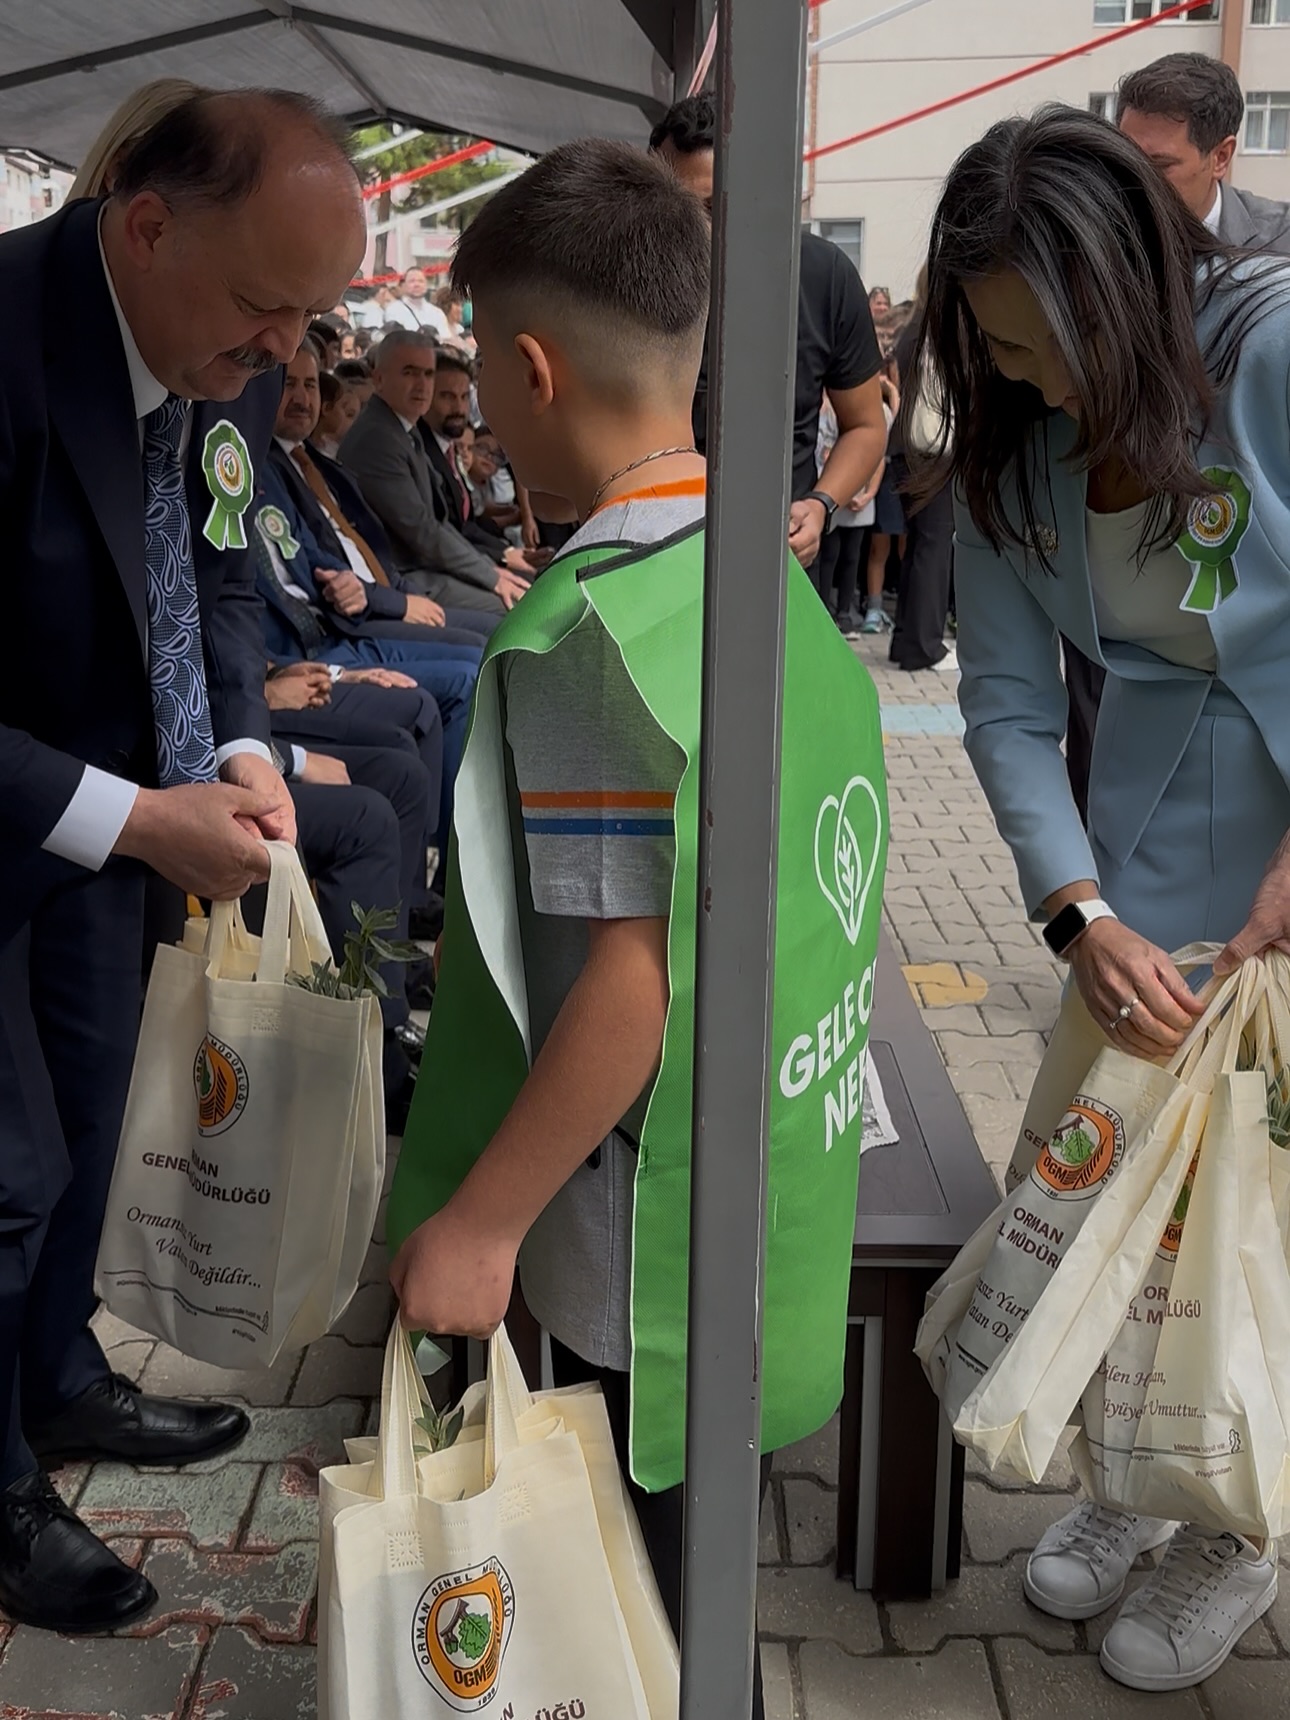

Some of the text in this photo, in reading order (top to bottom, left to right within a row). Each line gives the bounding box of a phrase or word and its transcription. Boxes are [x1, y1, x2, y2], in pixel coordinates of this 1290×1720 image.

[779, 956, 877, 1098] GELEC
[824, 1040, 869, 1153] NEF
[1043, 1156, 1068, 1185] OGM
[1013, 1206, 1065, 1246] ORMAN
[188, 1231, 212, 1256] Yurt
[968, 1299, 990, 1329] atan
[996, 1291, 1030, 1322] Yurt
[416, 1602, 432, 1666] ORMAN
[431, 1573, 473, 1597] GENEL
[453, 1667, 487, 1688] OGM
